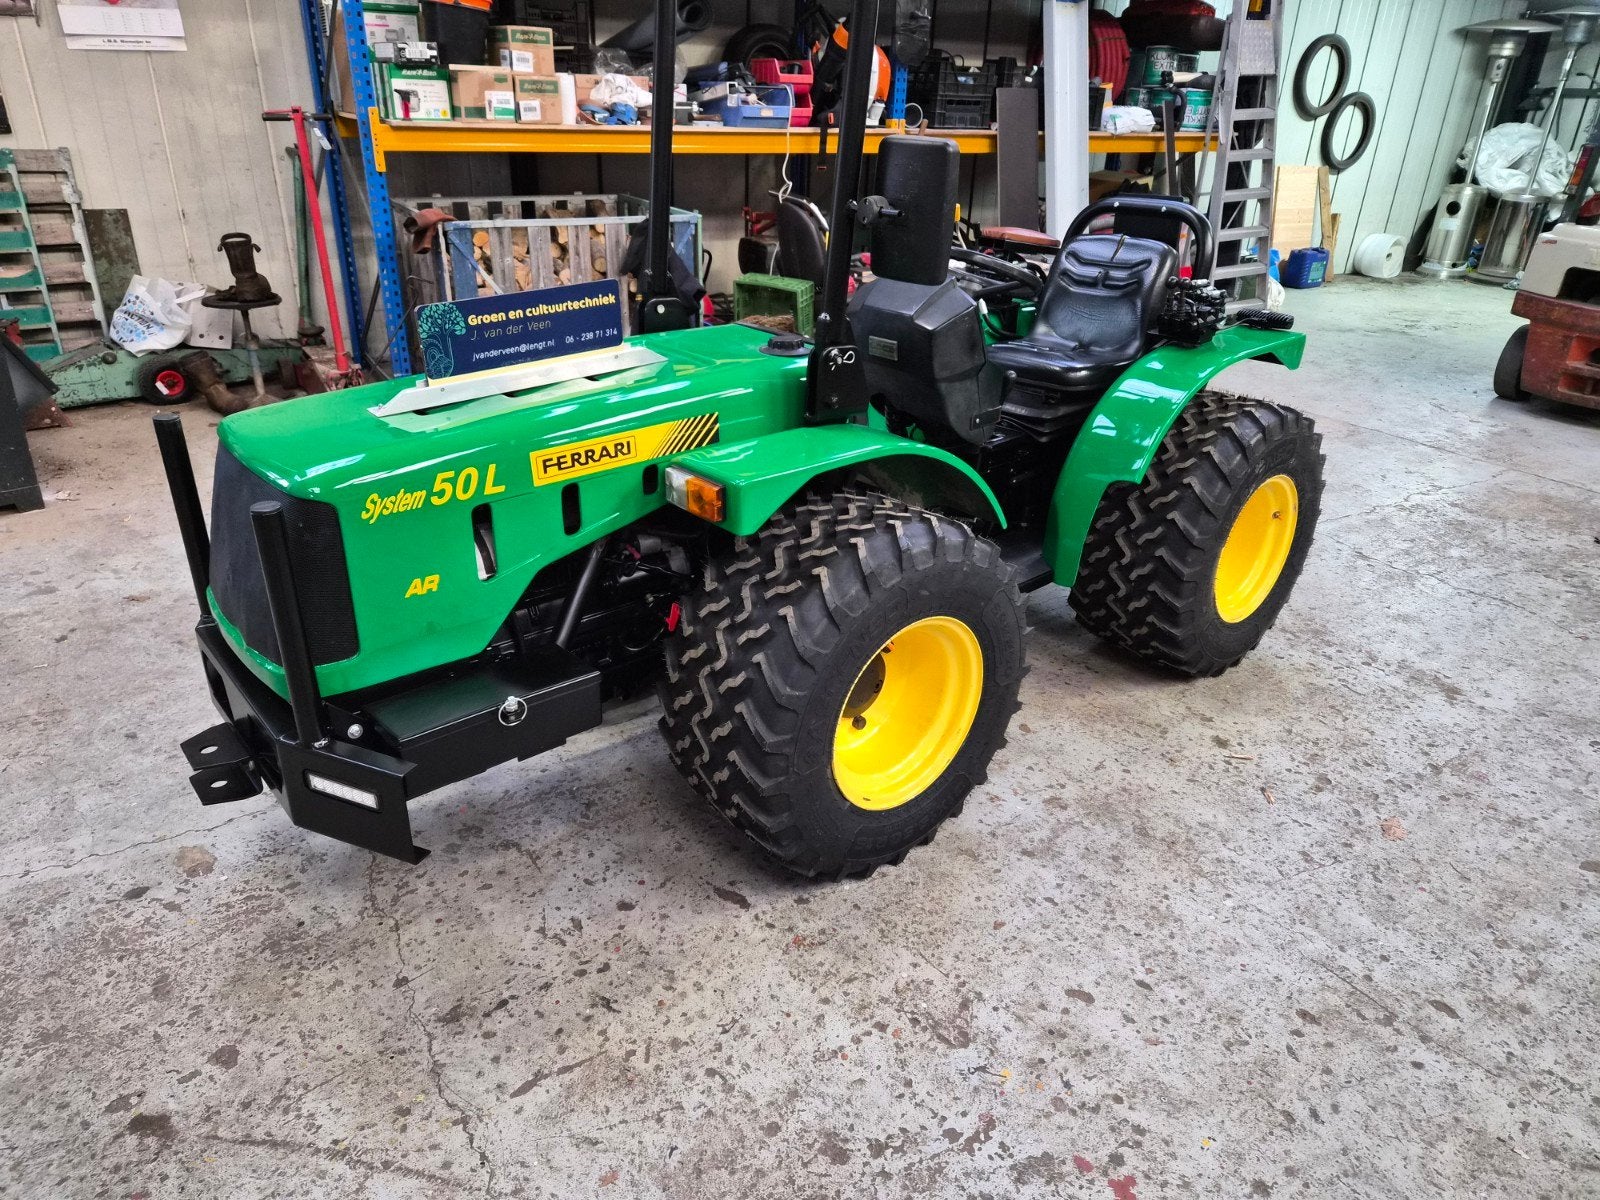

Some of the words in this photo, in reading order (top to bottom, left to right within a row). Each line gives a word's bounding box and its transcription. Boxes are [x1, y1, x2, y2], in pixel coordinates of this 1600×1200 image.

[467, 310, 506, 326] Groen
[508, 309, 524, 320] en
[525, 293, 616, 317] cultuurtechniek
[470, 329, 480, 341] J.
[484, 328, 503, 338] van
[506, 323, 523, 335] der
[527, 319, 551, 332] Veen
[565, 334, 574, 344] 06
[581, 331, 594, 342] 238
[595, 329, 604, 339] 71
[605, 328, 618, 337] 314
[472, 338, 555, 362] jvanderveen@lengt.nl
[542, 440, 631, 475] FERRARI
[361, 488, 426, 524] System
[430, 467, 478, 506] 50
[483, 463, 506, 497] L
[405, 574, 440, 599] AR
